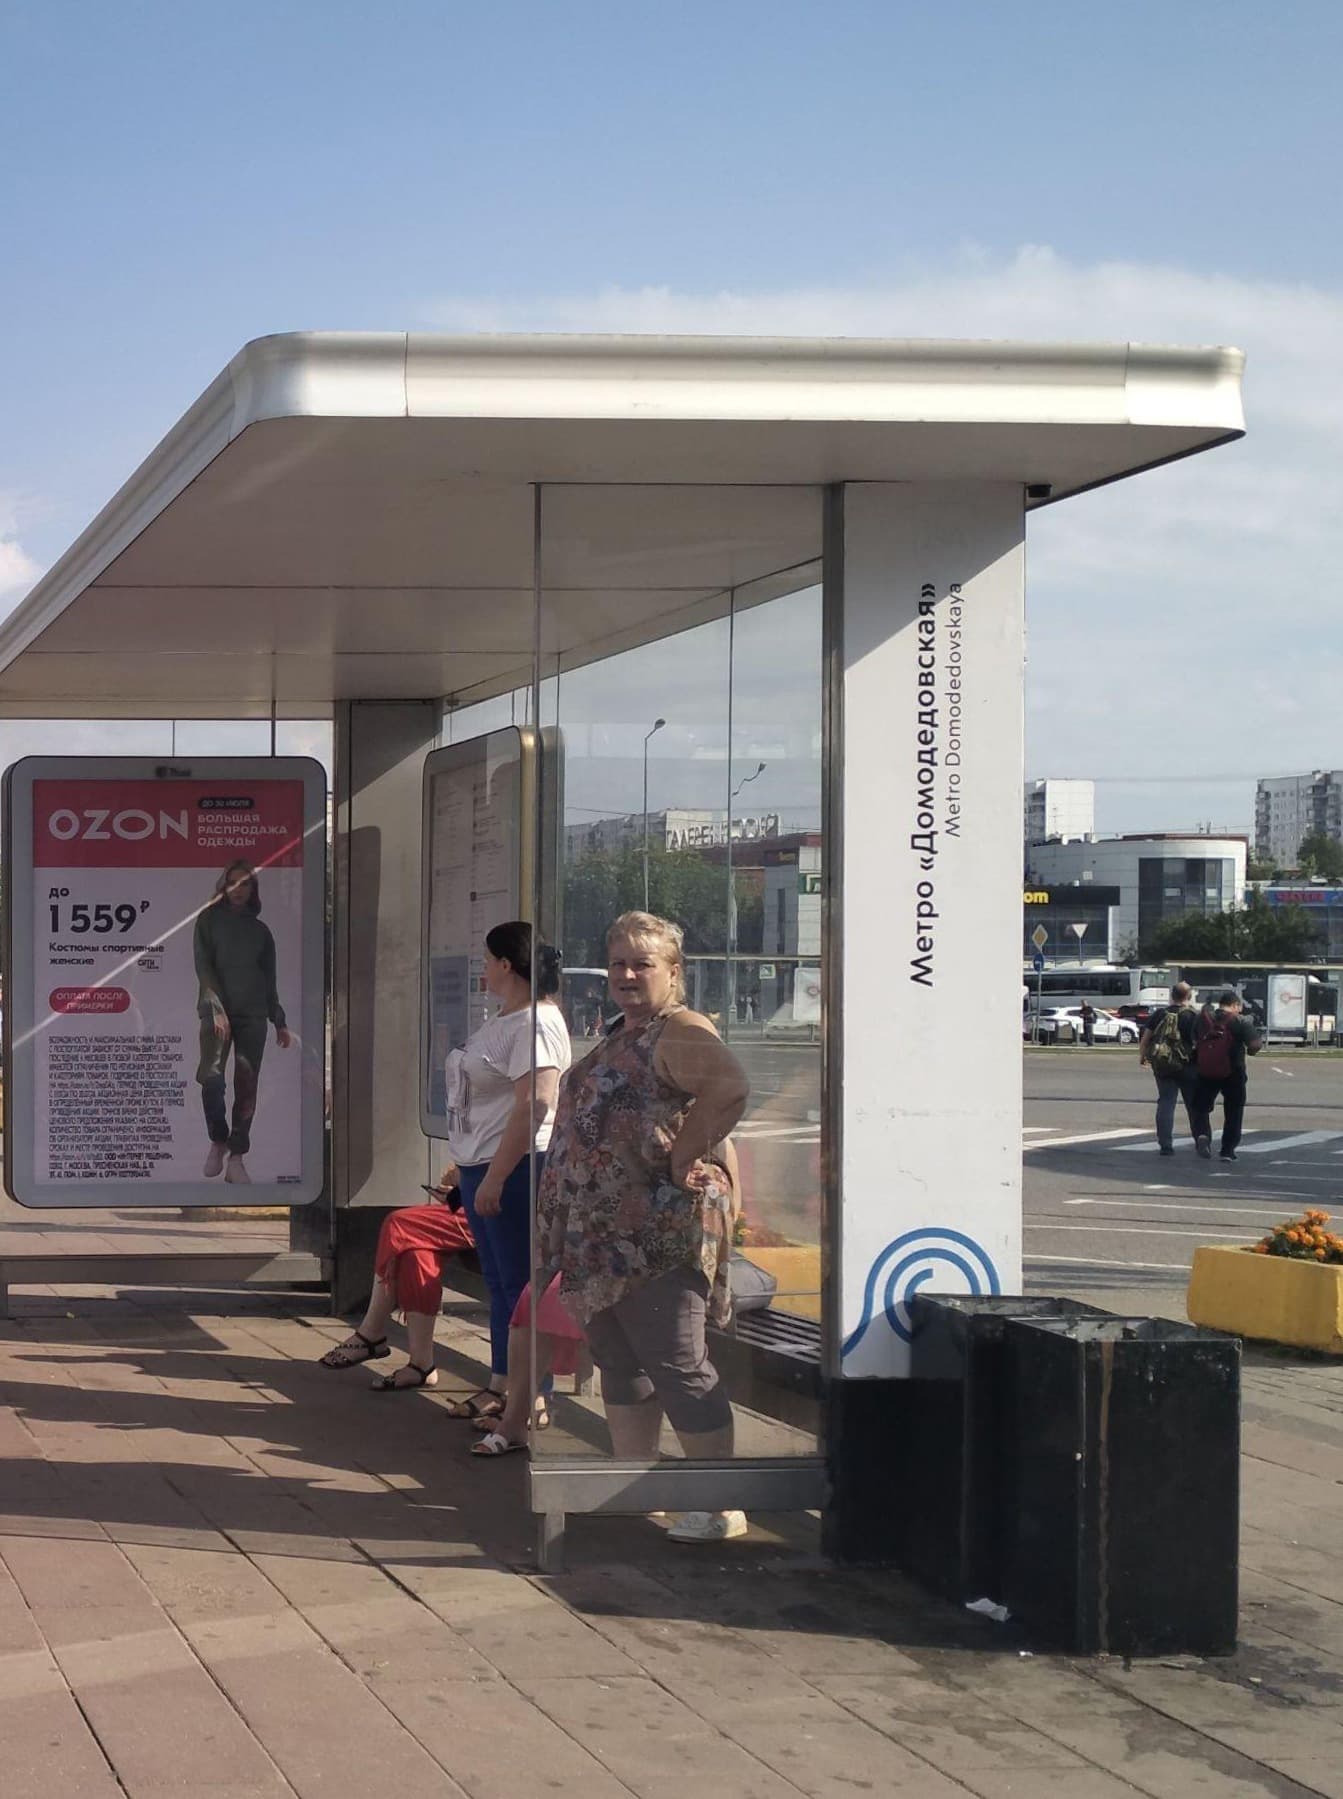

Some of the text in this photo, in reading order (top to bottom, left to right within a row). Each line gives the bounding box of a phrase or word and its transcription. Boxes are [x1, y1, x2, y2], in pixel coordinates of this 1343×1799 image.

[944, 583, 964, 838] Metro Domodedovskaya
[910, 582, 939, 988] Метро «Домодедовская»
[48, 809, 189, 840] OZON
[198, 814, 261, 824] БОЛЬШАЯ
[198, 826, 288, 836] РАСПРОДАЖА
[197, 837, 256, 847] ОДЕЖДЫ
[49, 888, 70, 899] до
[49, 942, 165, 954] Костюмы спортивные
